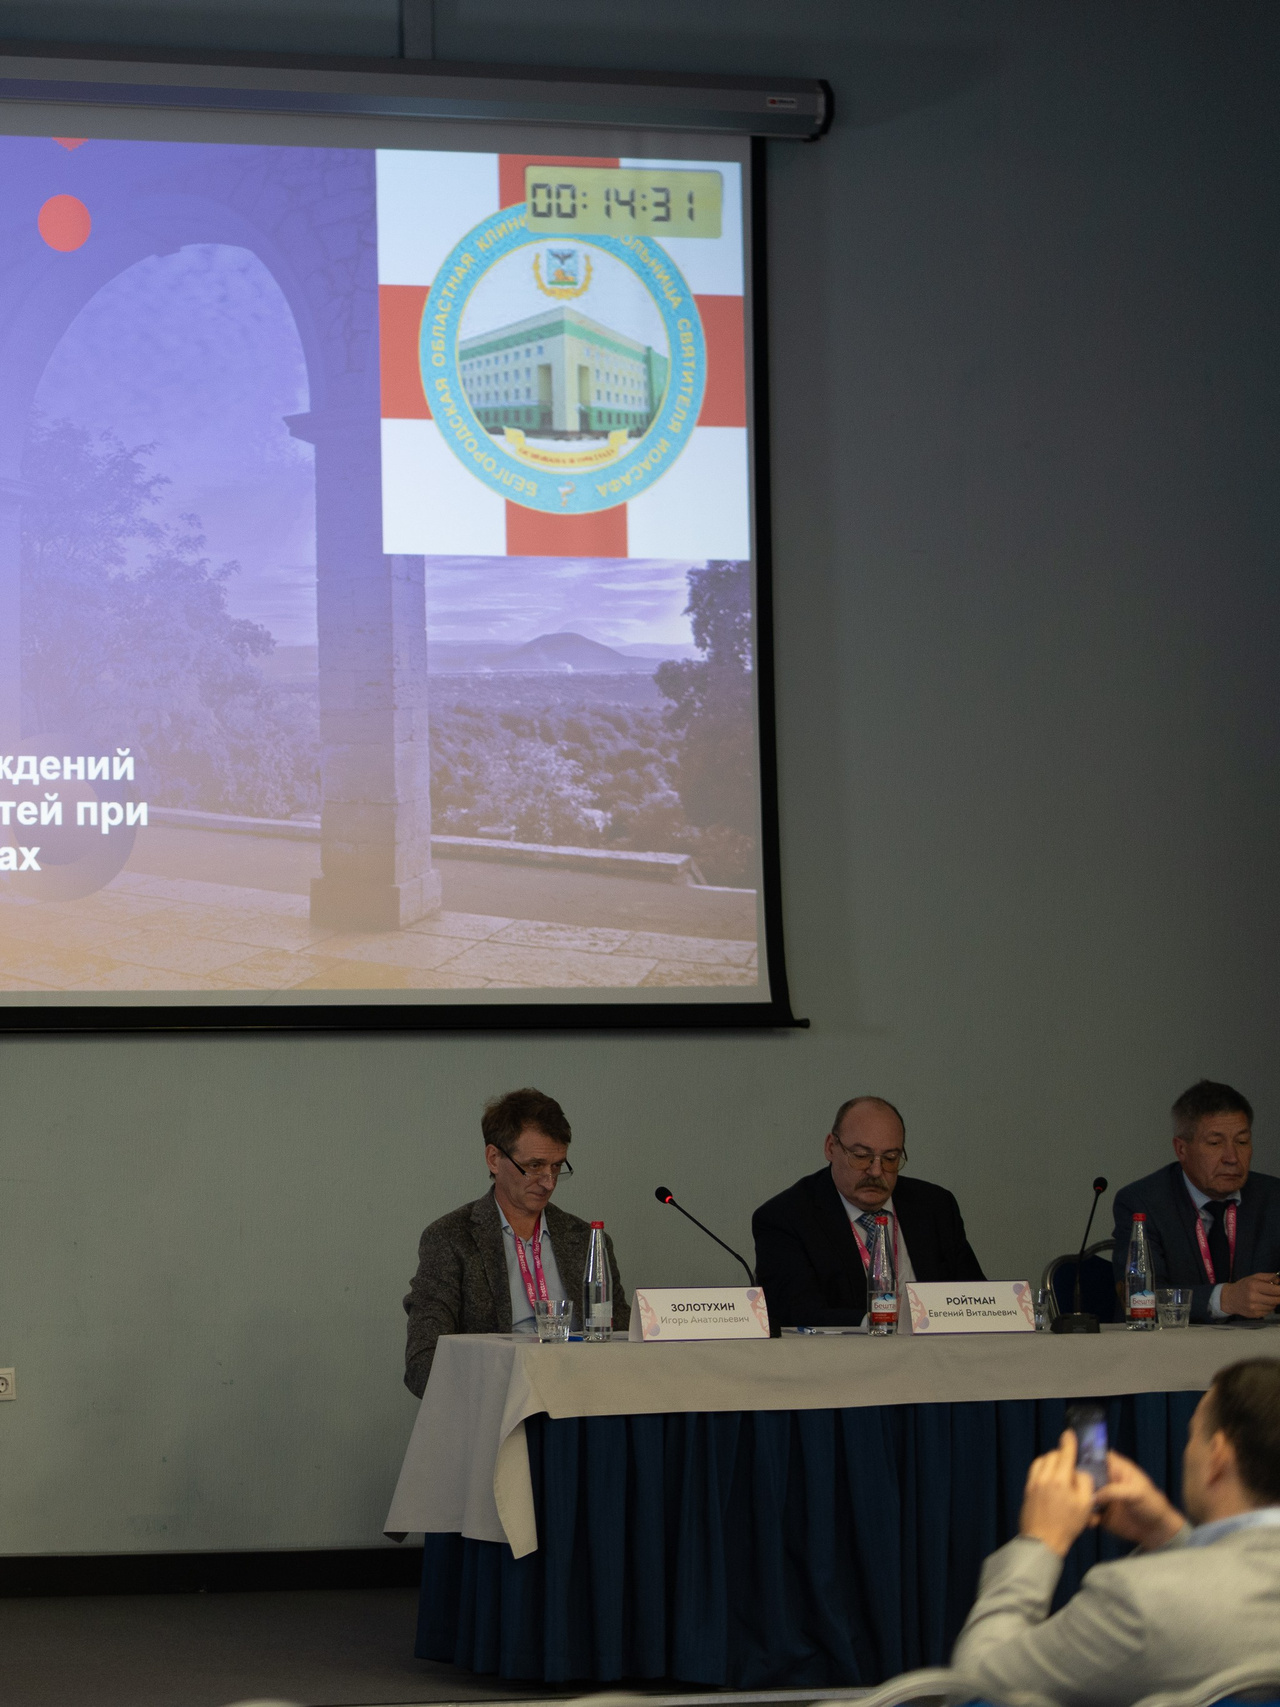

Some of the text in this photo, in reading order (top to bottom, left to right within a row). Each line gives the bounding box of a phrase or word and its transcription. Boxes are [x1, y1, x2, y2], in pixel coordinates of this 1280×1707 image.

[531, 183, 695, 222] 00:14:31
[611, 234, 683, 310] ОЛЬНИЦА
[431, 252, 477, 368] ОБЛАСТНАЯ
[667, 317, 696, 434] СВЯТИТЕЛЯ
[434, 377, 539, 497] БЕЛГОРОДСКАЯ
[595, 437, 671, 498] ИОАСАФА
[76, 801, 149, 835] при
[671, 1302, 736, 1312] ЗОЛОТУХИН
[928, 1308, 1018, 1318] Евгений Витальевич
[946, 1295, 996, 1306] РОЙТМАН
[660, 1315, 750, 1327] Игорь Анатольевич
